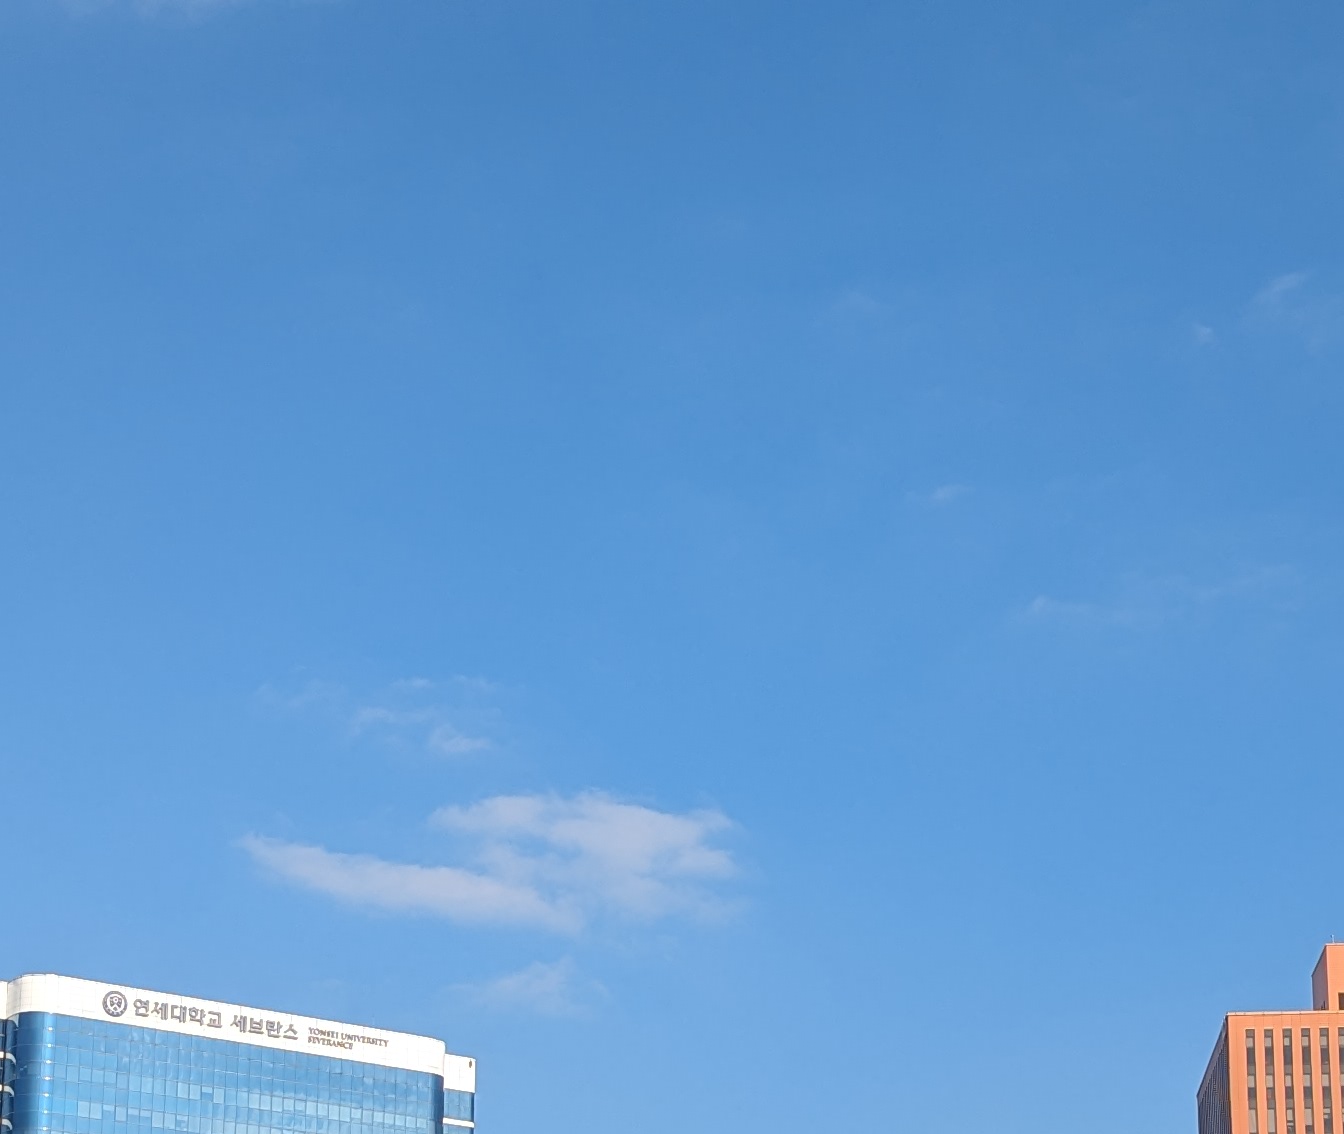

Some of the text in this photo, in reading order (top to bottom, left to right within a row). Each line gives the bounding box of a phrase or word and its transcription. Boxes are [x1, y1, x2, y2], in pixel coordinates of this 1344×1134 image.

[133, 998, 299, 1041] 연세대학교 세브란스
[307, 1035, 354, 1051] SEVERANCE
[308, 1026, 390, 1048] YONSEI UNIVERSITY
